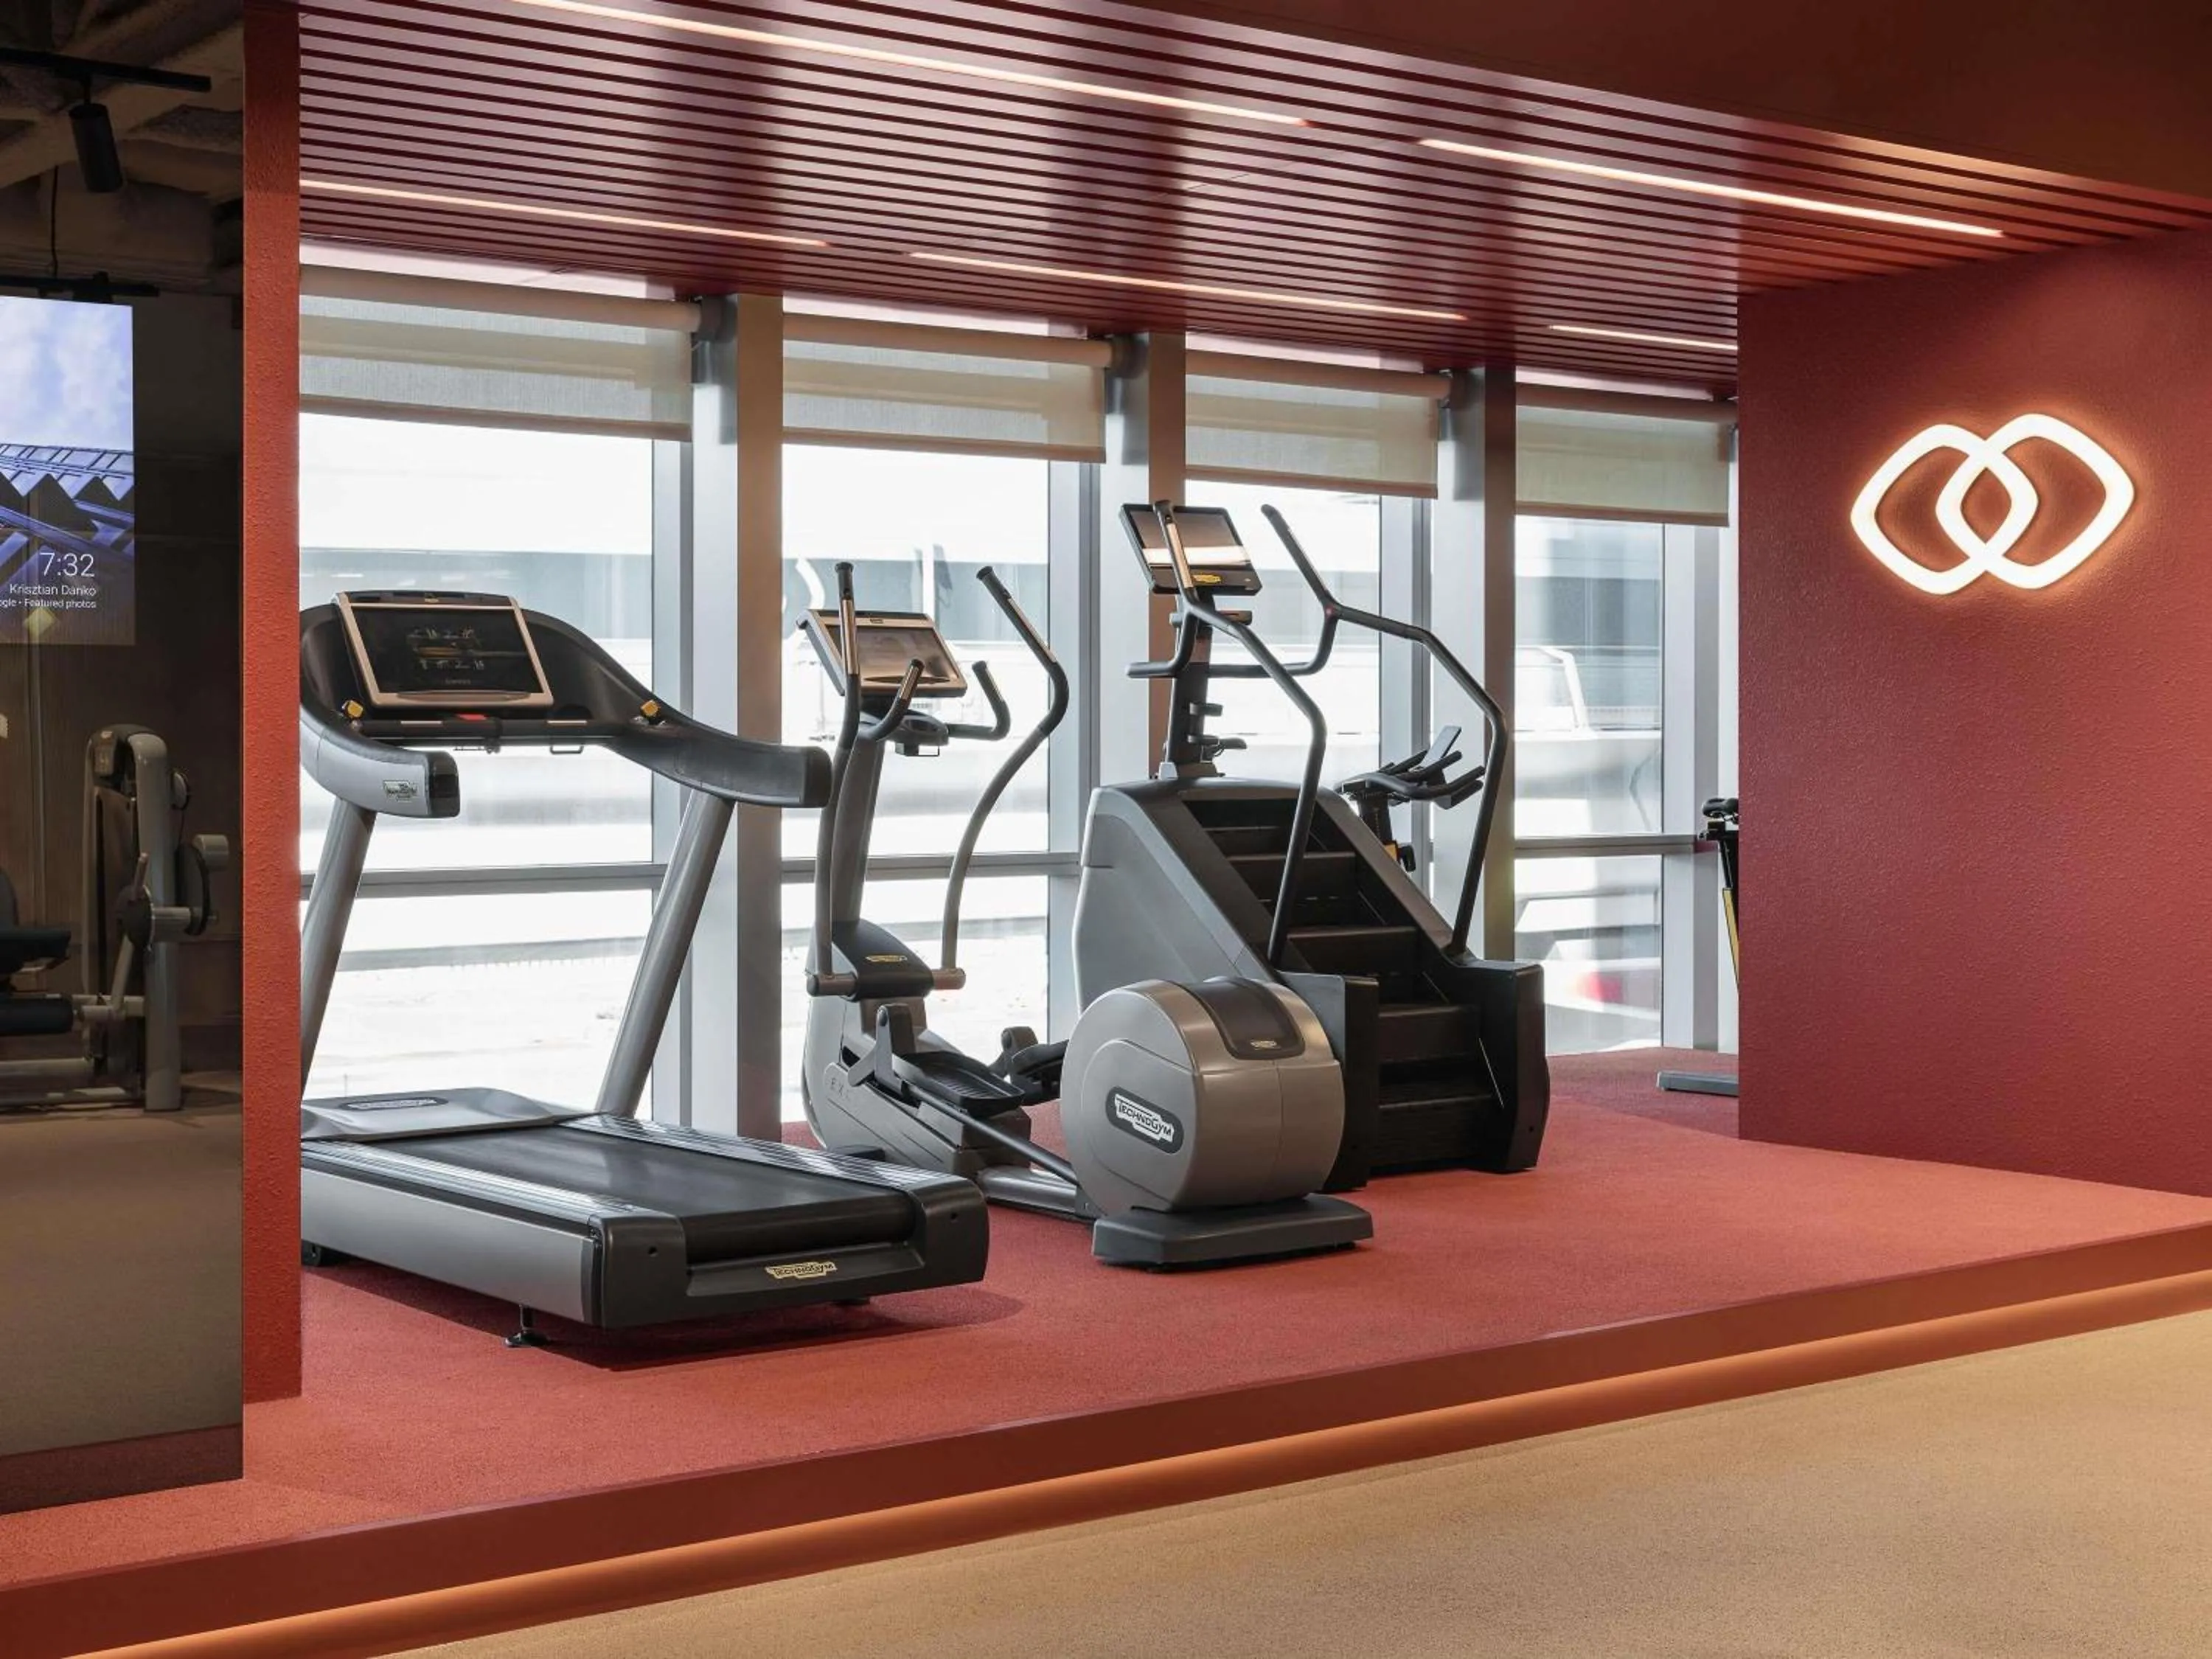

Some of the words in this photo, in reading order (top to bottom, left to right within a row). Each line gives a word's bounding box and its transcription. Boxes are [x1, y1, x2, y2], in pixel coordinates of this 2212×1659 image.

[39, 552, 95, 577] 7:32
[24, 598, 64, 608] Featured
[66, 599, 97, 609] photos
